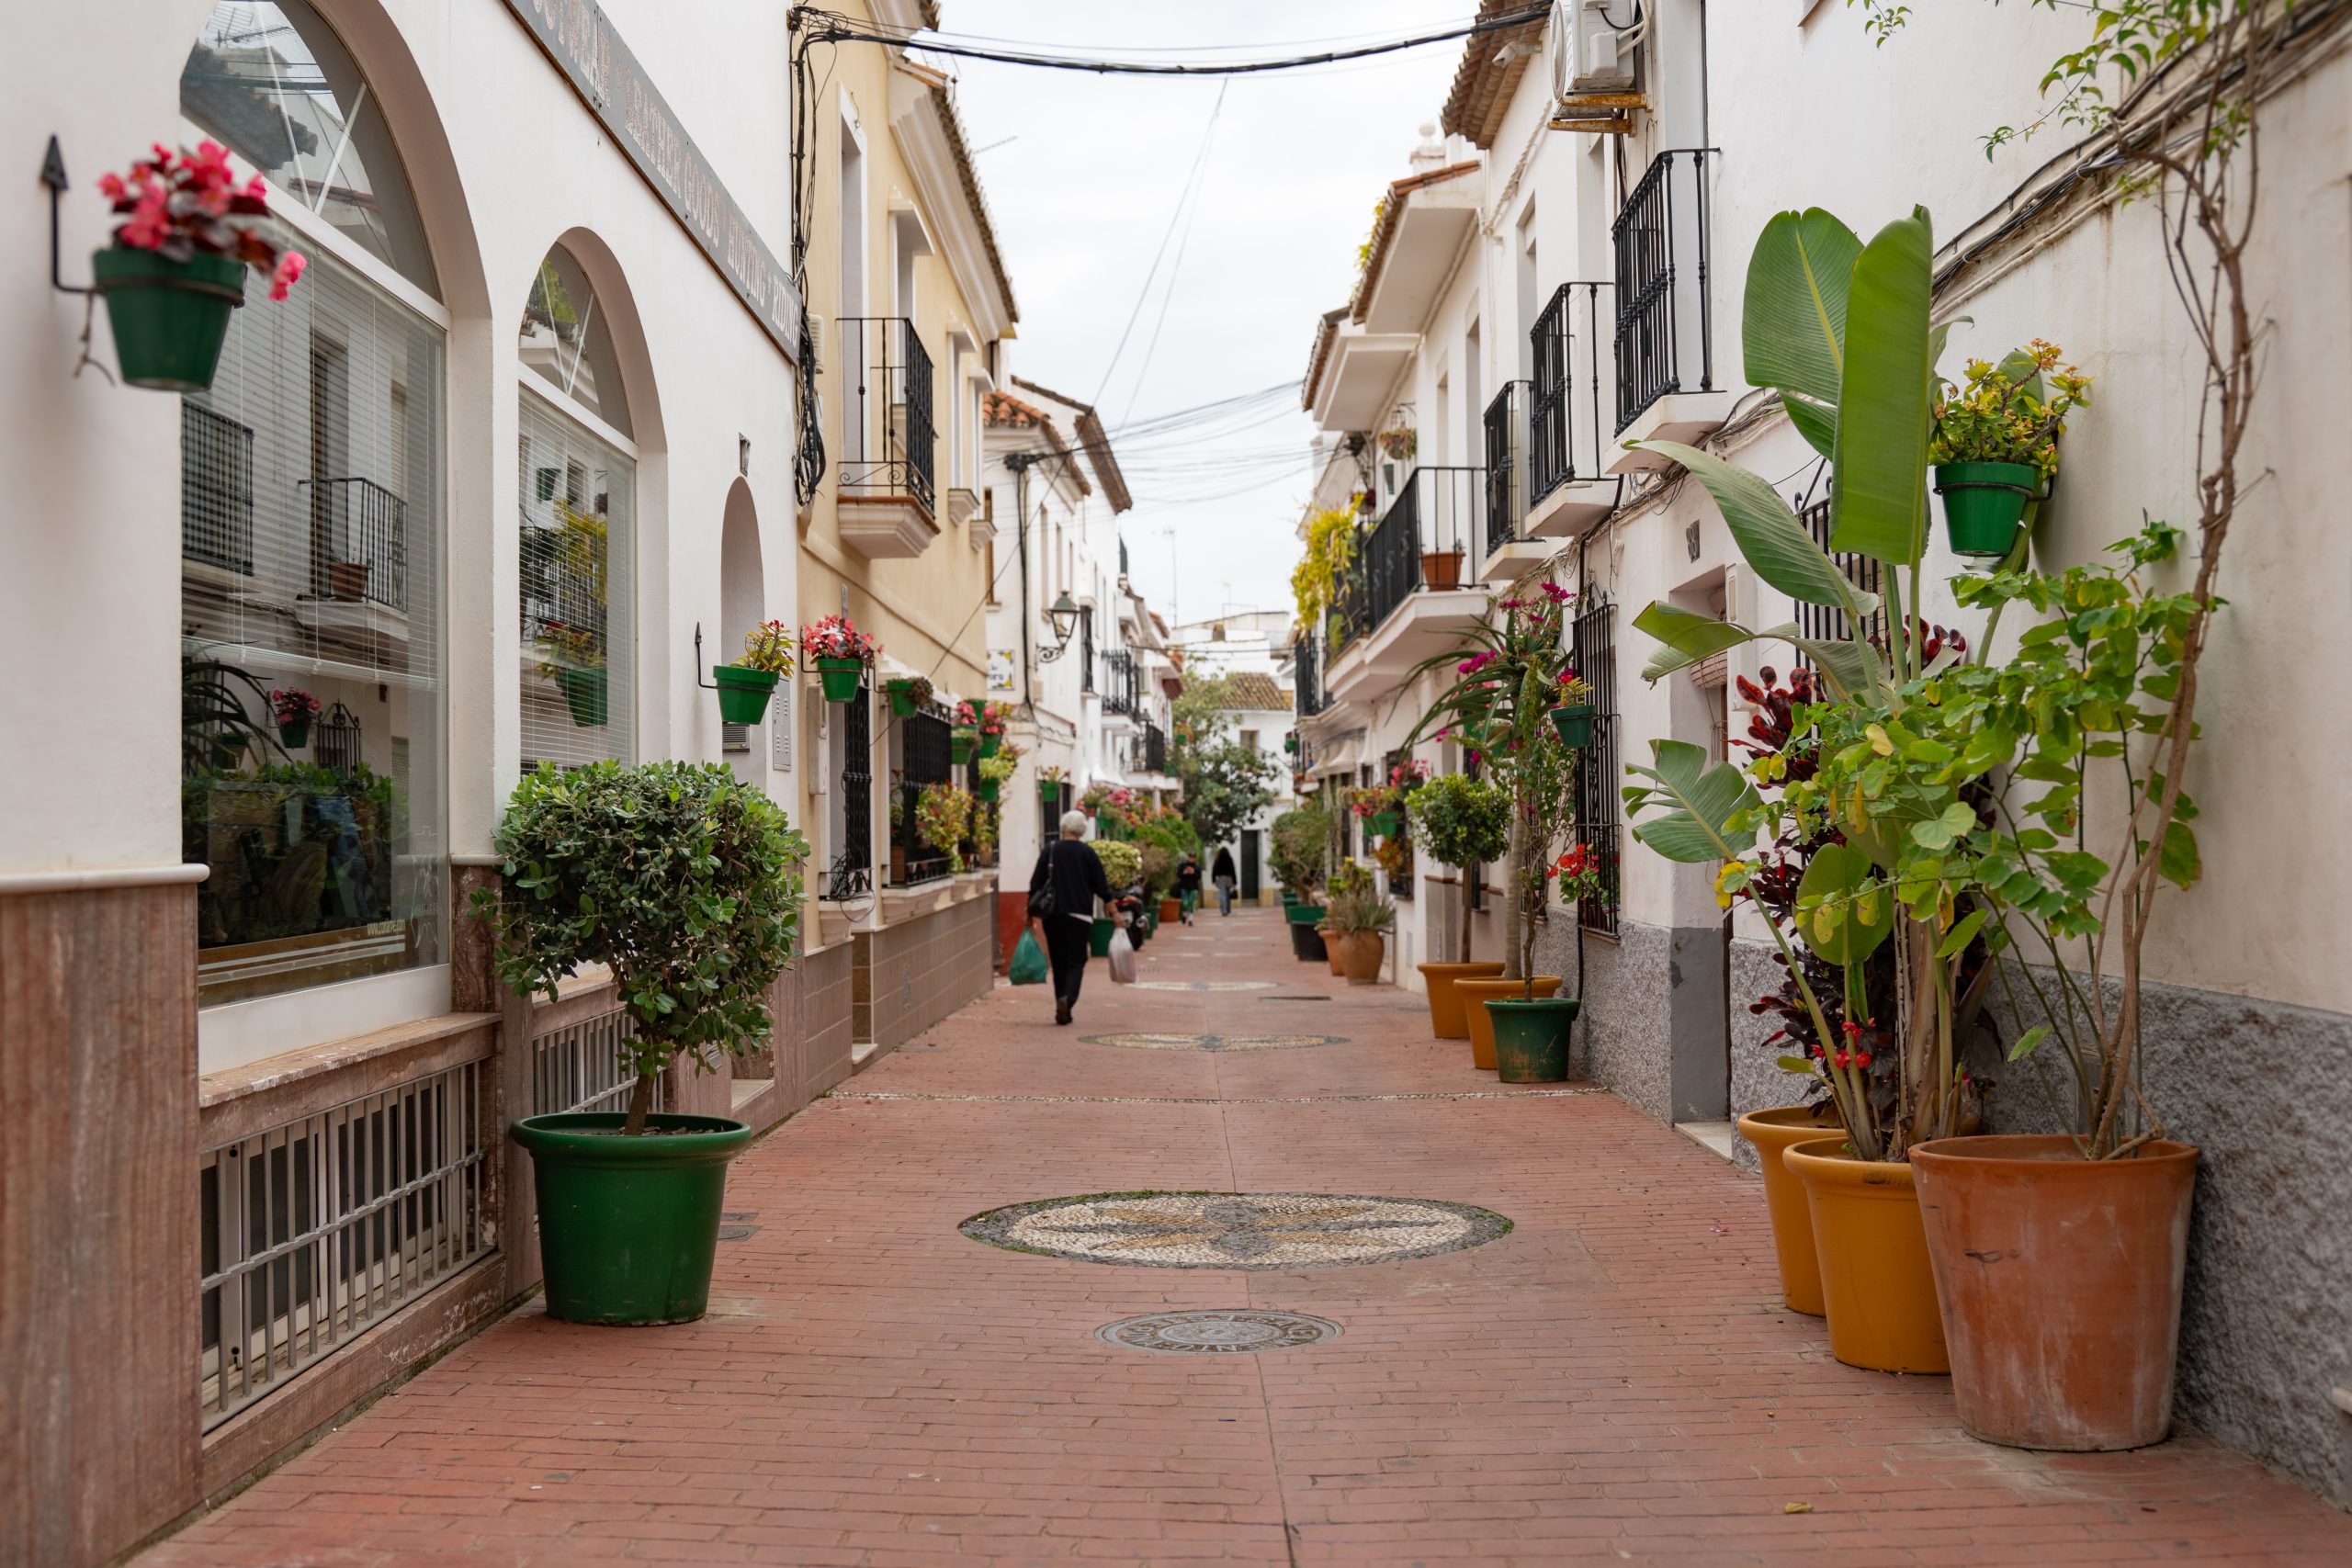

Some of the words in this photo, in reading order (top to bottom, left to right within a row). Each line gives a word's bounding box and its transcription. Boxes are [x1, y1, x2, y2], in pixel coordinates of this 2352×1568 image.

[625, 59, 682, 199] LEATHER
[684, 152, 720, 248] GOODS
[727, 214, 766, 309] HUNTING
[771, 275, 799, 348] RIDING
